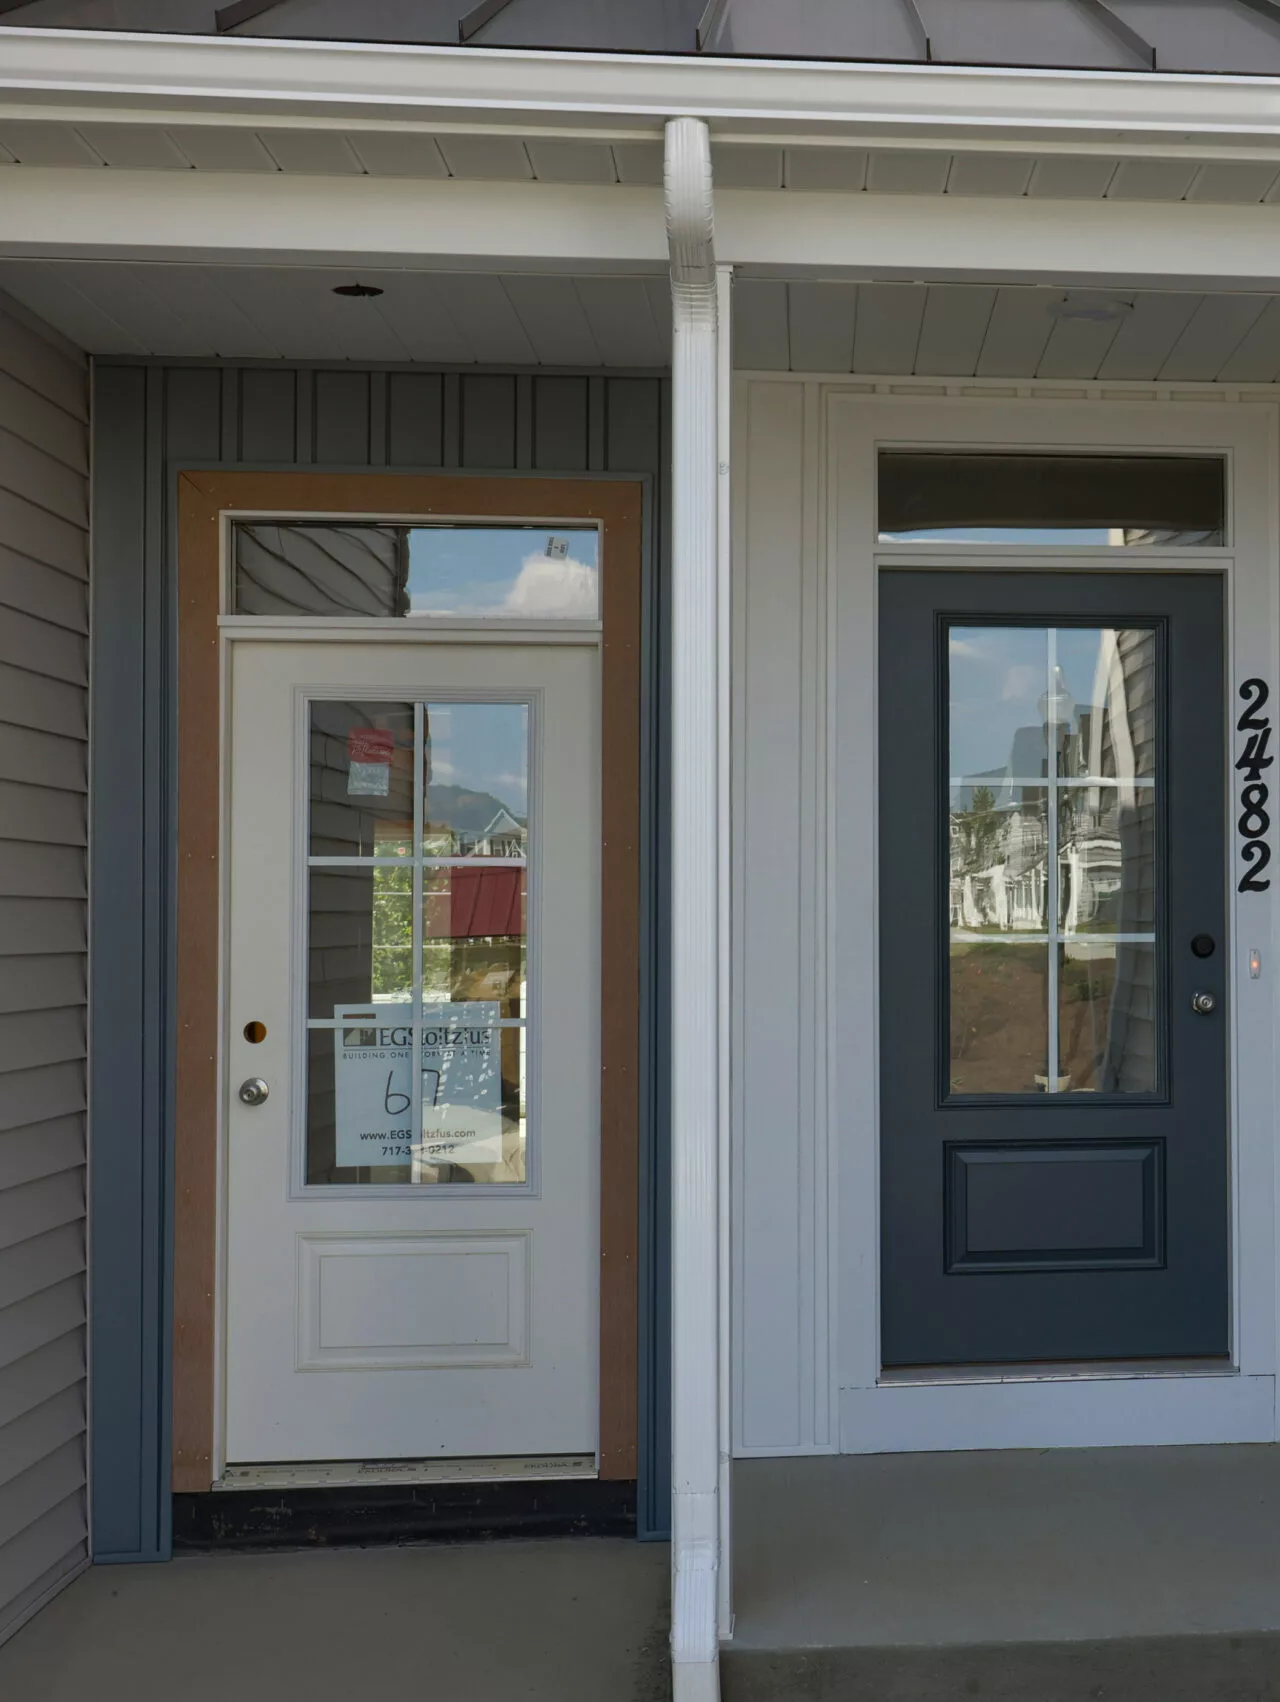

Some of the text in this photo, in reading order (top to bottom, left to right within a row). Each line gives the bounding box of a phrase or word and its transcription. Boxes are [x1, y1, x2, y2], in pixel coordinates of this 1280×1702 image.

[1235, 678, 1274, 893] 2482
[342, 1052, 386, 1060] BUILDING
[384, 1068, 441, 1115] 67
[360, 1128, 476, 1141] www.EGSltzfus.com
[382, 1144, 455, 1156] 717-3-0212
